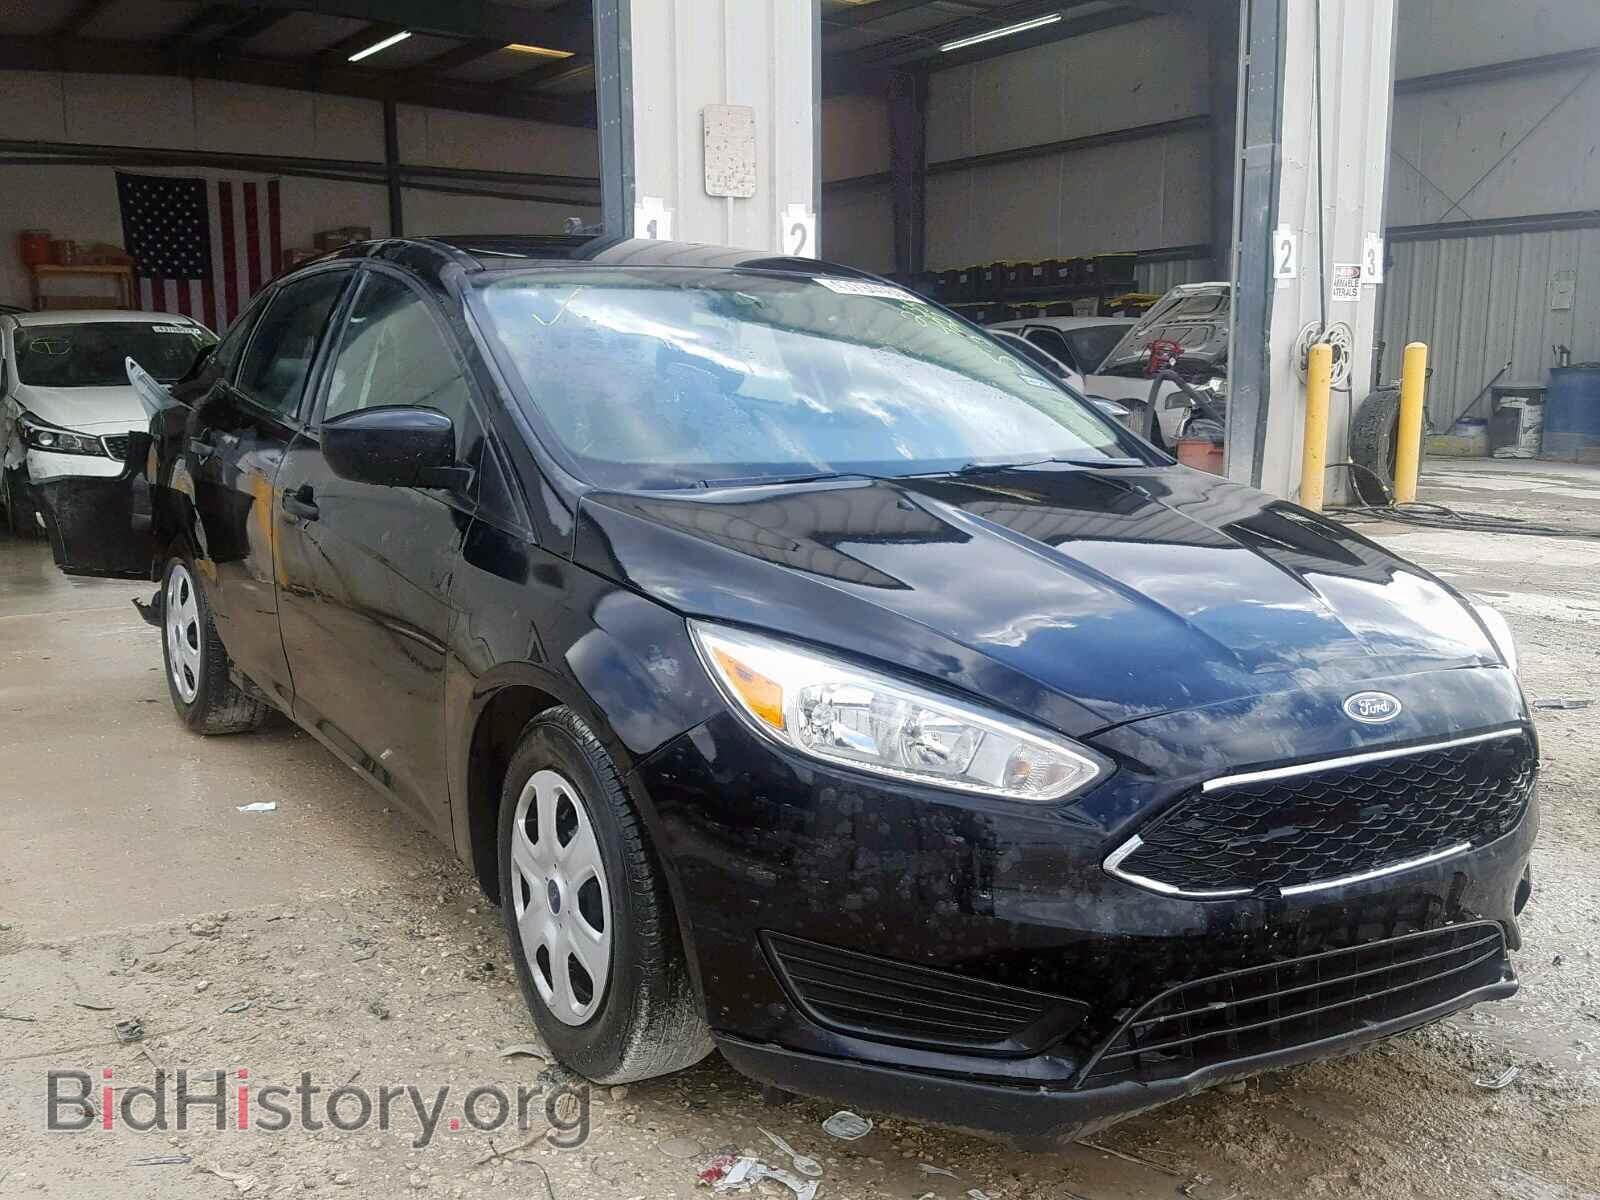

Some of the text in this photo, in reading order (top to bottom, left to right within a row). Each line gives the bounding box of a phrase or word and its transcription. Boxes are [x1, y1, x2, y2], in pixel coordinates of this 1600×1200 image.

[790, 222, 807, 256] 2
[1280, 239, 1292, 274] 2
[1367, 248, 1376, 276] 3
[1359, 698, 1390, 715] Ford
